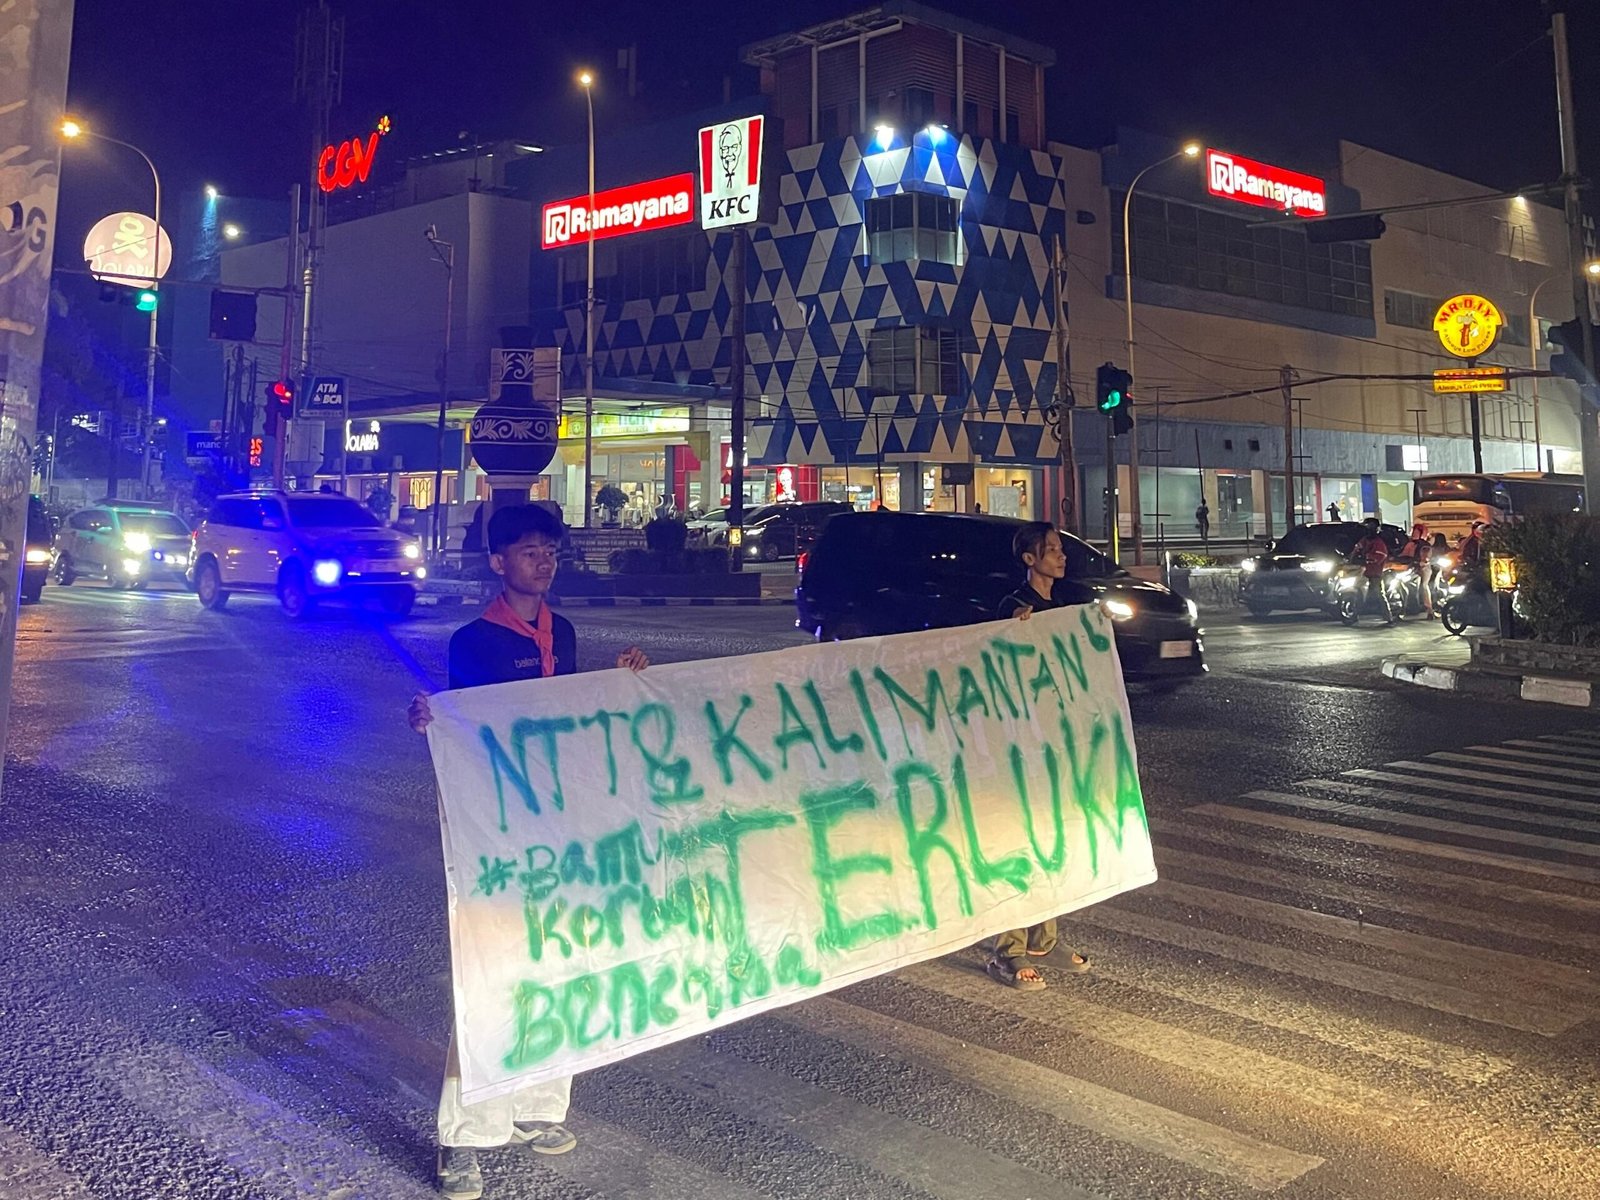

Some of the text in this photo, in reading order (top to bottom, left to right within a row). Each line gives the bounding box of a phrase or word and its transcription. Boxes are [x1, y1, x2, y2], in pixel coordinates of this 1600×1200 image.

[318, 132, 379, 192] CGV
[1233, 165, 1324, 211] Ramayana
[571, 191, 689, 228] Ramayana
[708, 194, 751, 220] KFC
[316, 383, 338, 393] ATM
[322, 394, 342, 404] BCA
[667, 707, 1149, 953] TERLUKA
